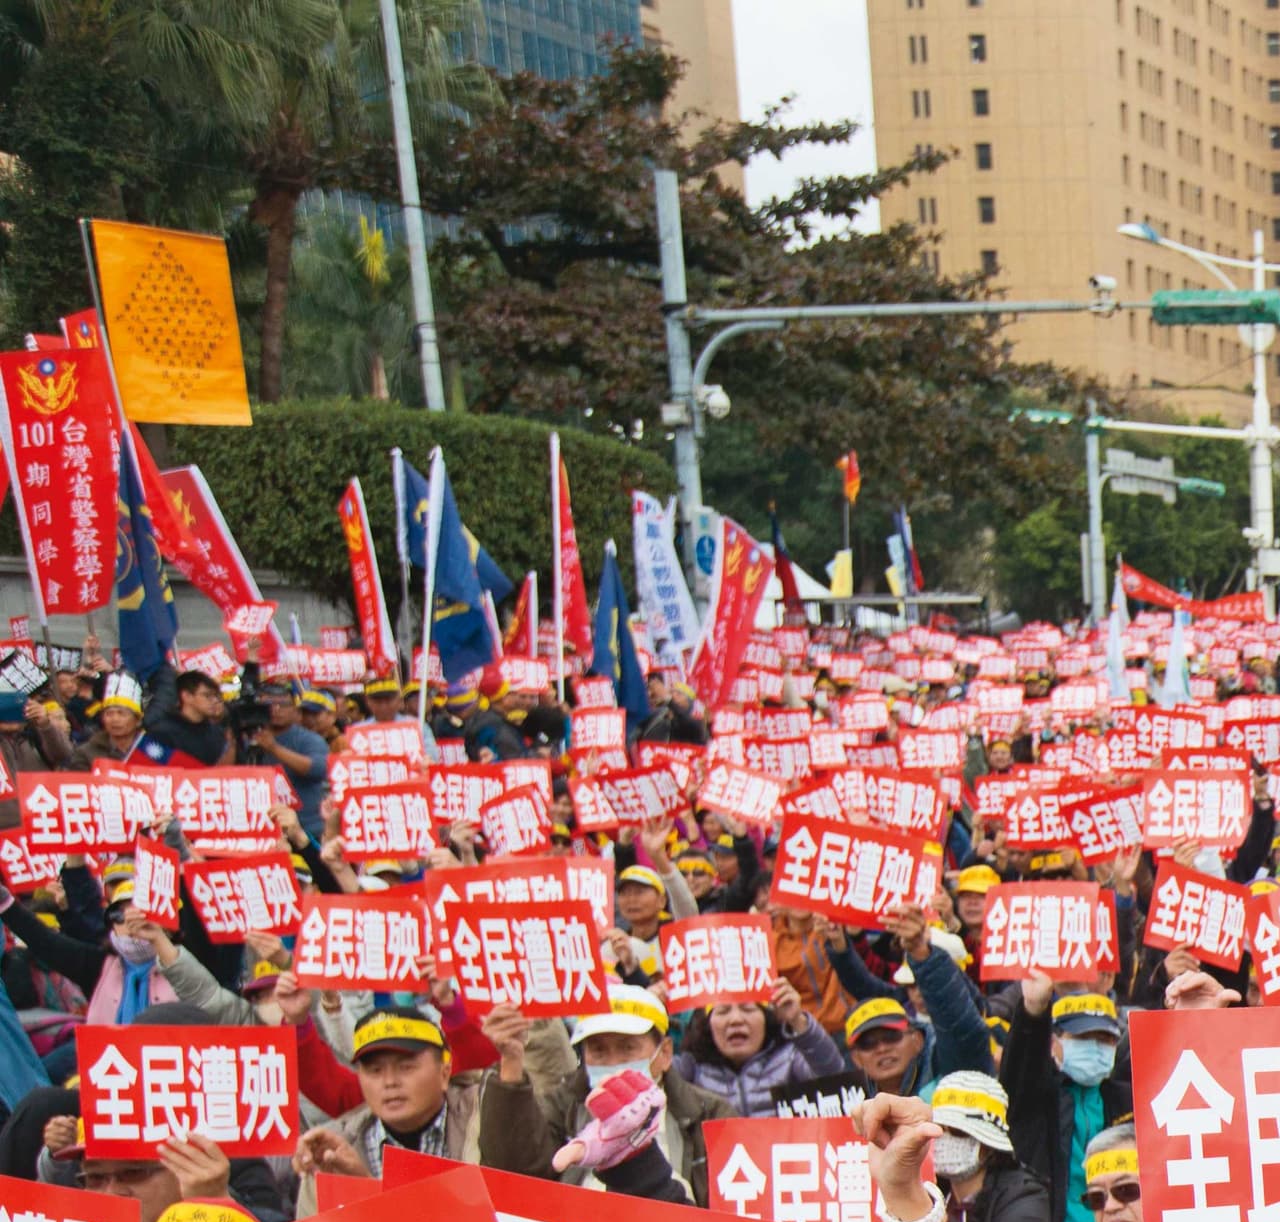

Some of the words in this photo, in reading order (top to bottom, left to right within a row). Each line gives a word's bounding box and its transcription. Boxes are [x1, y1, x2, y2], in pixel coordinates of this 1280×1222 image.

[26, 783, 157, 845] 全民遭殃
[175, 778, 275, 831] 全民遭殃
[343, 792, 435, 852] 全民遭殃
[604, 768, 686, 823] 全民遭殃
[1148, 779, 1245, 838] 全民遭殃
[192, 862, 302, 933] 全民遭殃
[777, 825, 914, 914] 全民遭殃
[296, 906, 421, 981] 全民遭殃
[983, 894, 1093, 969] 全民遭殃
[1150, 875, 1246, 961] 全民遭殃
[452, 916, 601, 1004] 全民遭殃
[665, 925, 772, 1000] 全民遭殃
[88, 1042, 292, 1143] 全民遭殃
